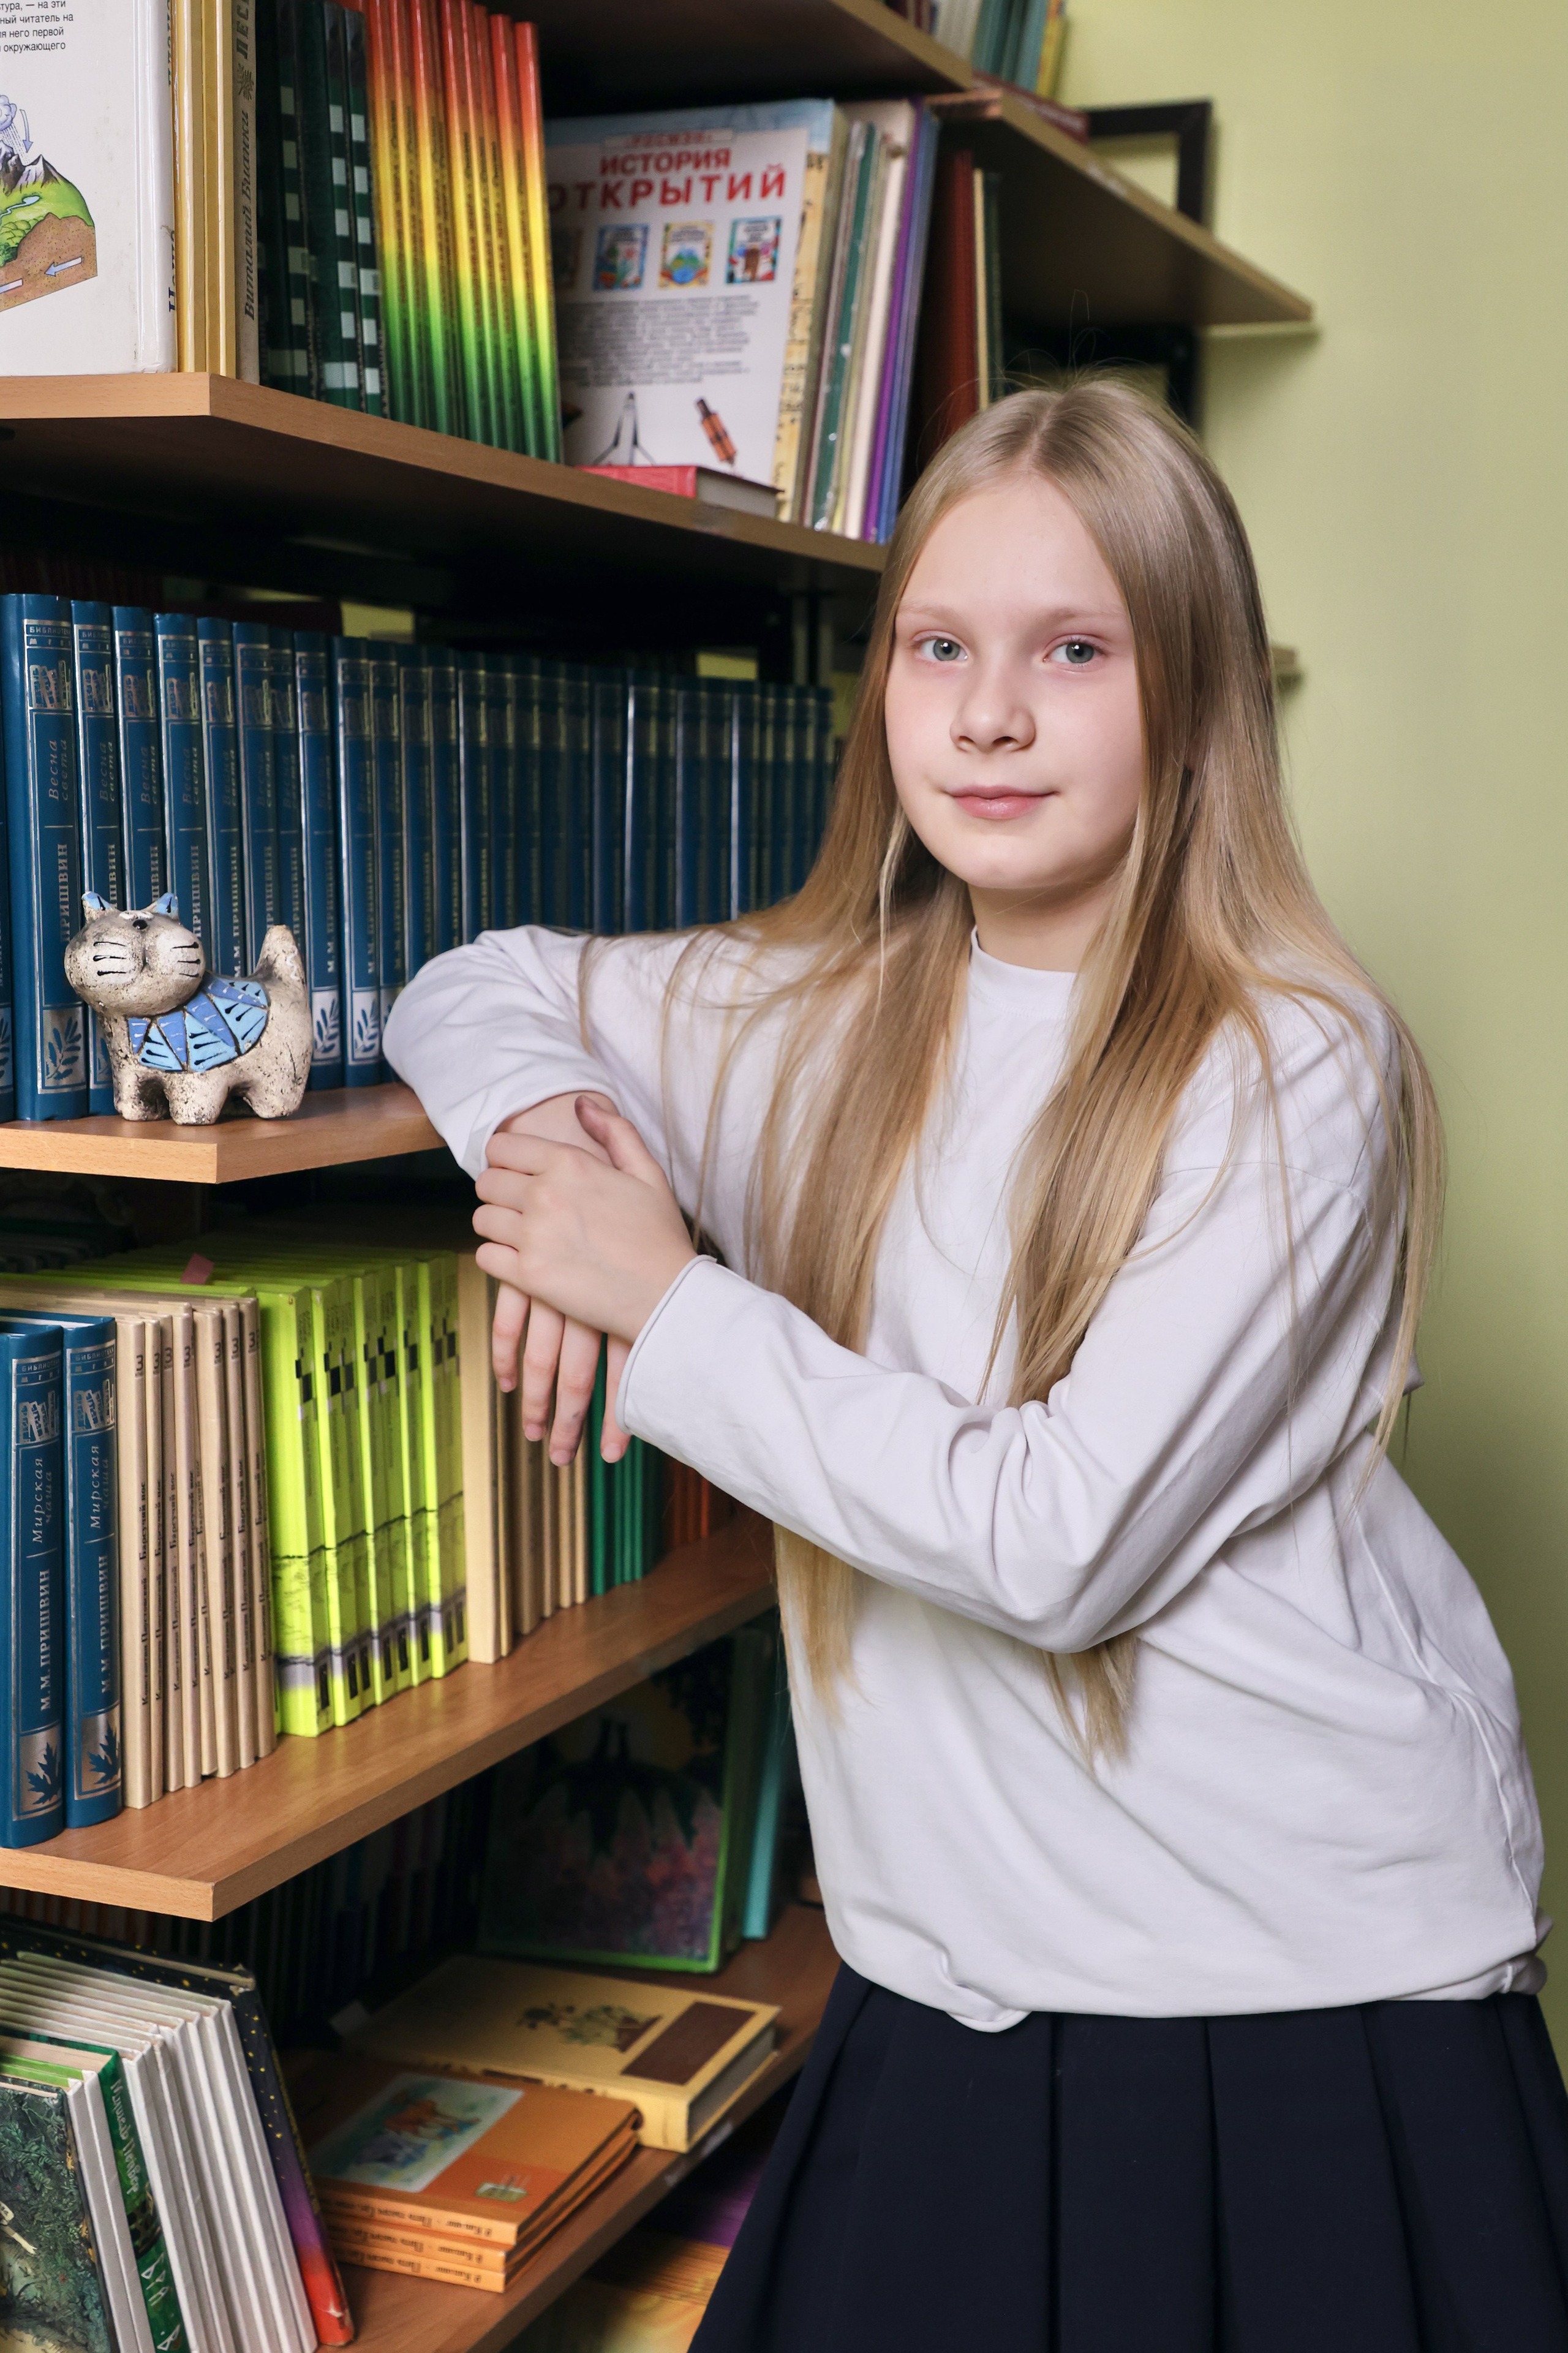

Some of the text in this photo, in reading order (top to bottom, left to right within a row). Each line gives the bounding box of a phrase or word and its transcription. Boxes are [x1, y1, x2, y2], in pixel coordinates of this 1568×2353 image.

[0, 2, 23, 12] тура,
[20, 14, 60, 23] читатель
[32, 26, 64, 39] первой
[4, 42, 66, 54] окружающего
[600, 148, 733, 176] ИСТОРИЯ
[549, 163, 786, 214] ОТКРЫТИЙ
[241, 110, 255, 320] Виталий Бианки
[48, 739, 59, 801] Весна
[60, 738, 69, 801] света
[107, 844, 118, 909] ШВИН
[149, 846, 160, 903] ШВИН
[184, 1346, 191, 1362] 3
[214, 1342, 221, 1359] 3
[232, 1338, 239, 1354] 3
[136, 1354, 144, 1372] 3
[154, 1353, 160, 1369] 3
[164, 1348, 172, 1364] 3
[90, 1446, 103, 1529] Мирская
[32, 1457, 46, 1544] Мирская
